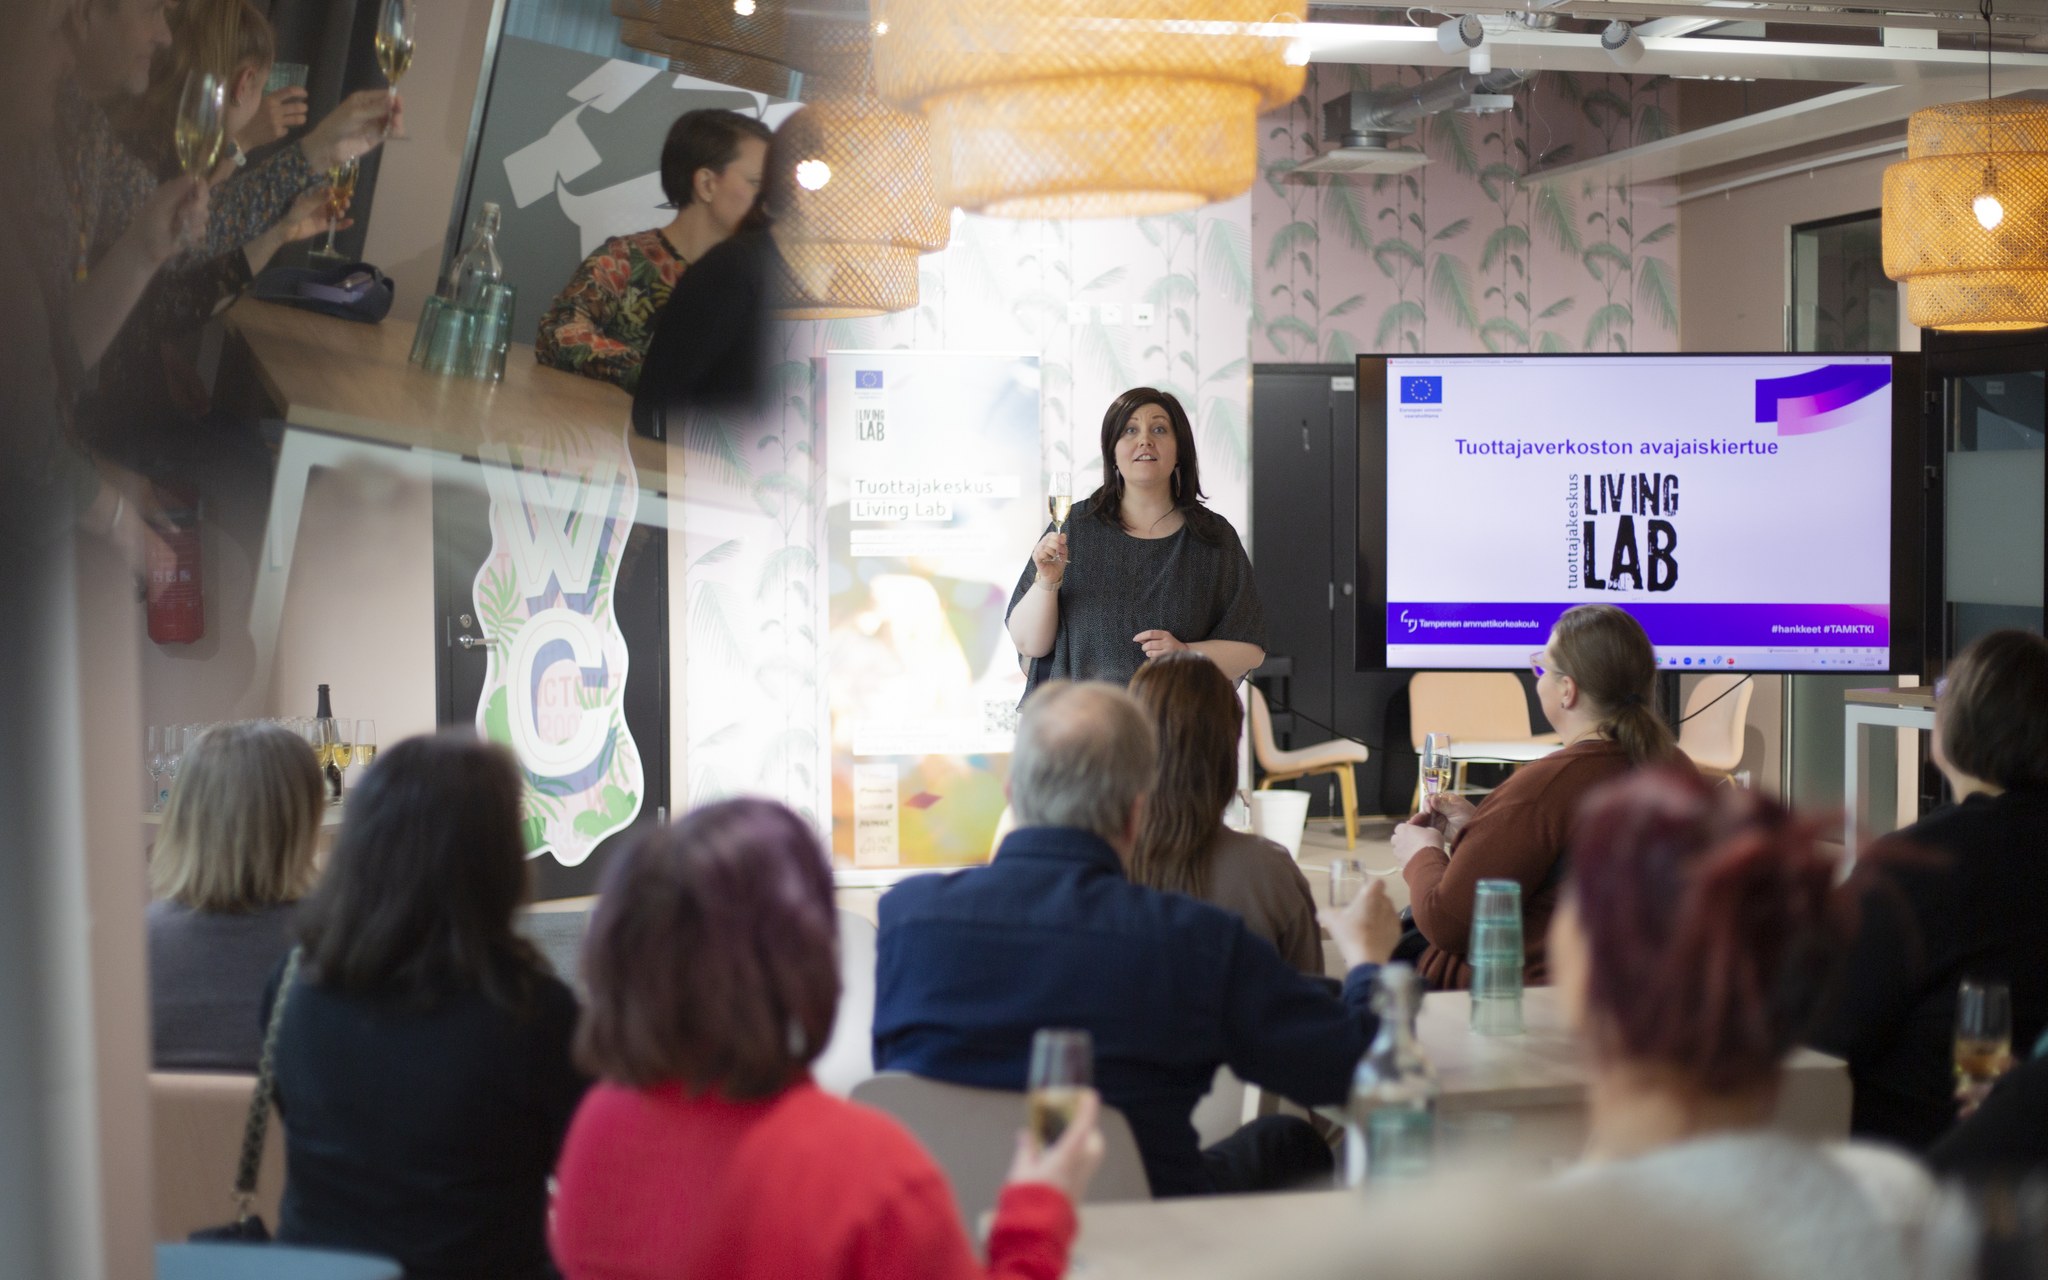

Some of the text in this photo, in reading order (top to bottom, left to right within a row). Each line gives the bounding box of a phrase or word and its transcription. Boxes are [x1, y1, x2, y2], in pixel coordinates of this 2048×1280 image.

[859, 409, 885, 421] LIVING
[859, 421, 885, 441] LAB
[1454, 438, 1779, 459] Tuottajaverkoston avajaiskiertue
[855, 478, 993, 498] Tuottajakeskus
[1583, 472, 1679, 517] LIVING
[856, 501, 946, 520] Living Lab
[1566, 473, 1581, 589] tuottajakeskus
[1583, 514, 1679, 592] LAB
[1419, 619, 1539, 629] Tampereen ammattikorkeakoulu
[1771, 624, 1875, 634] #hankkeet #TAMKTKI
